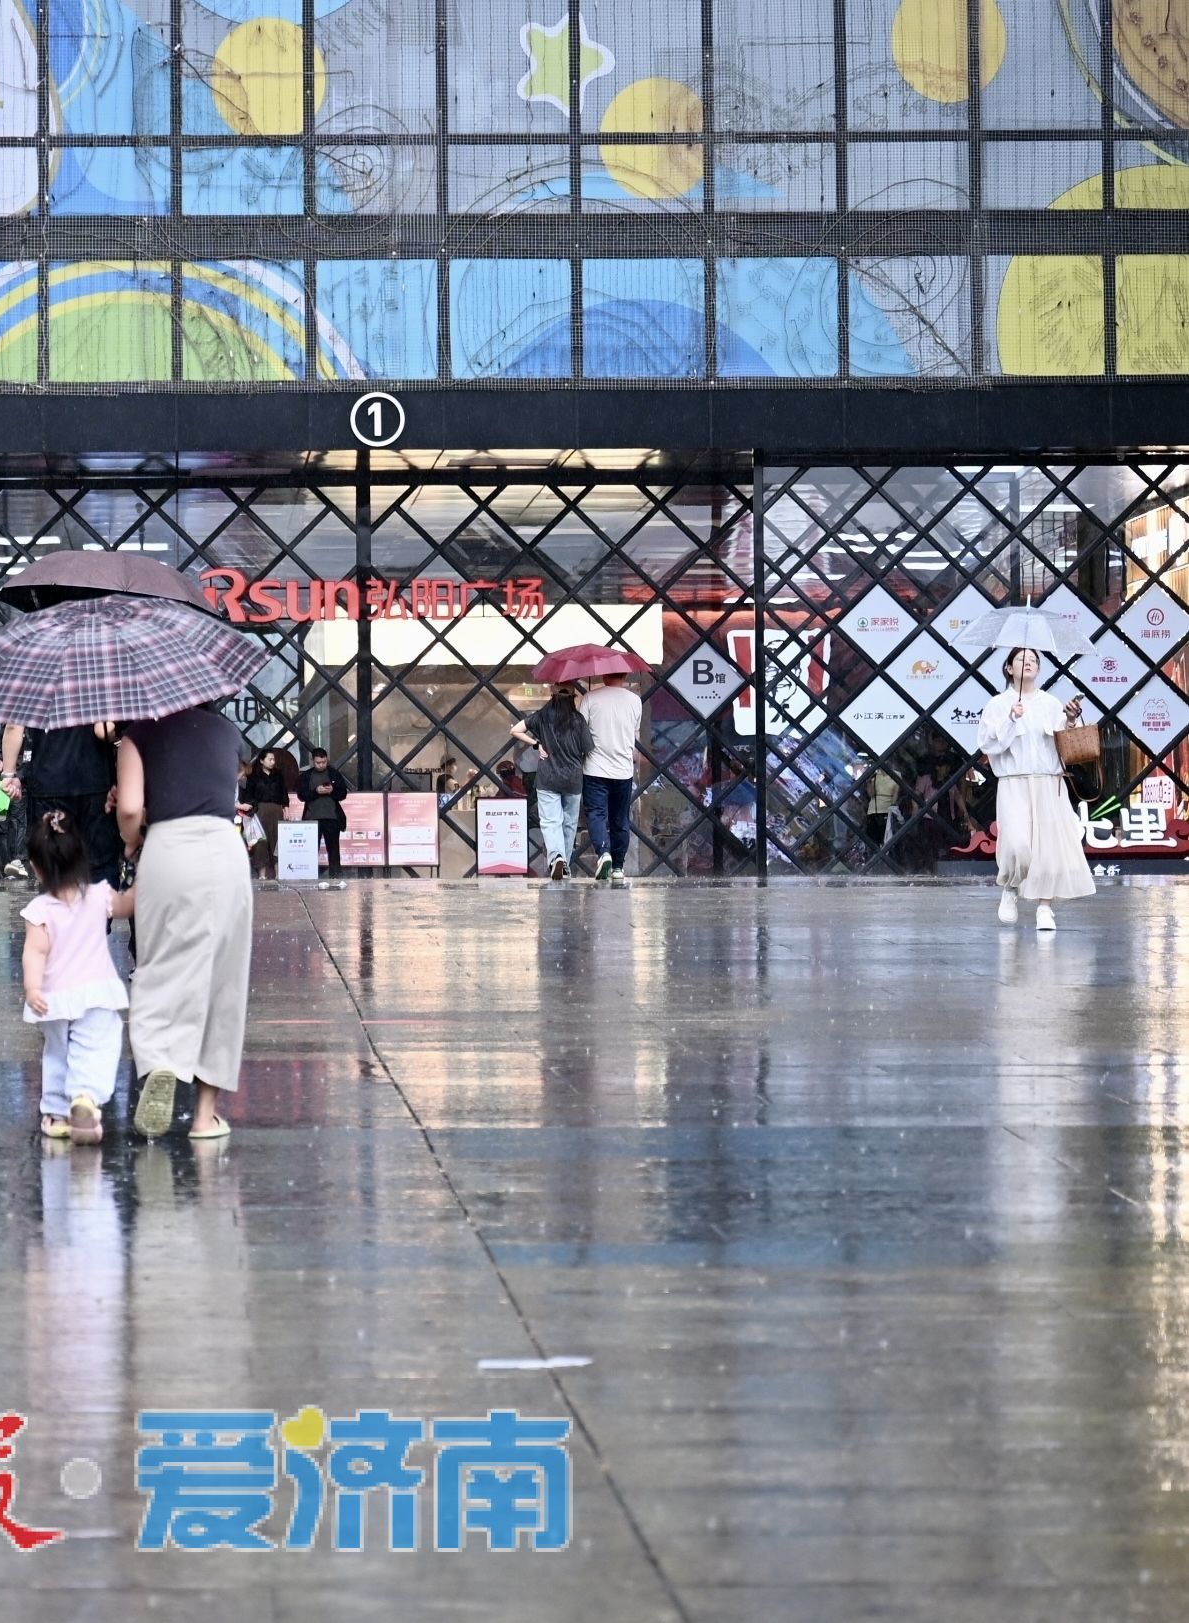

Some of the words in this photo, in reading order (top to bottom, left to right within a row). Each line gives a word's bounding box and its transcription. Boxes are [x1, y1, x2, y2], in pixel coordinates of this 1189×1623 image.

[200, 568, 360, 622] Rsun
[365, 577, 545, 621] 弘阳广场
[870, 617, 899, 627] 家家悦
[1141, 629, 1171, 639] 海底捞
